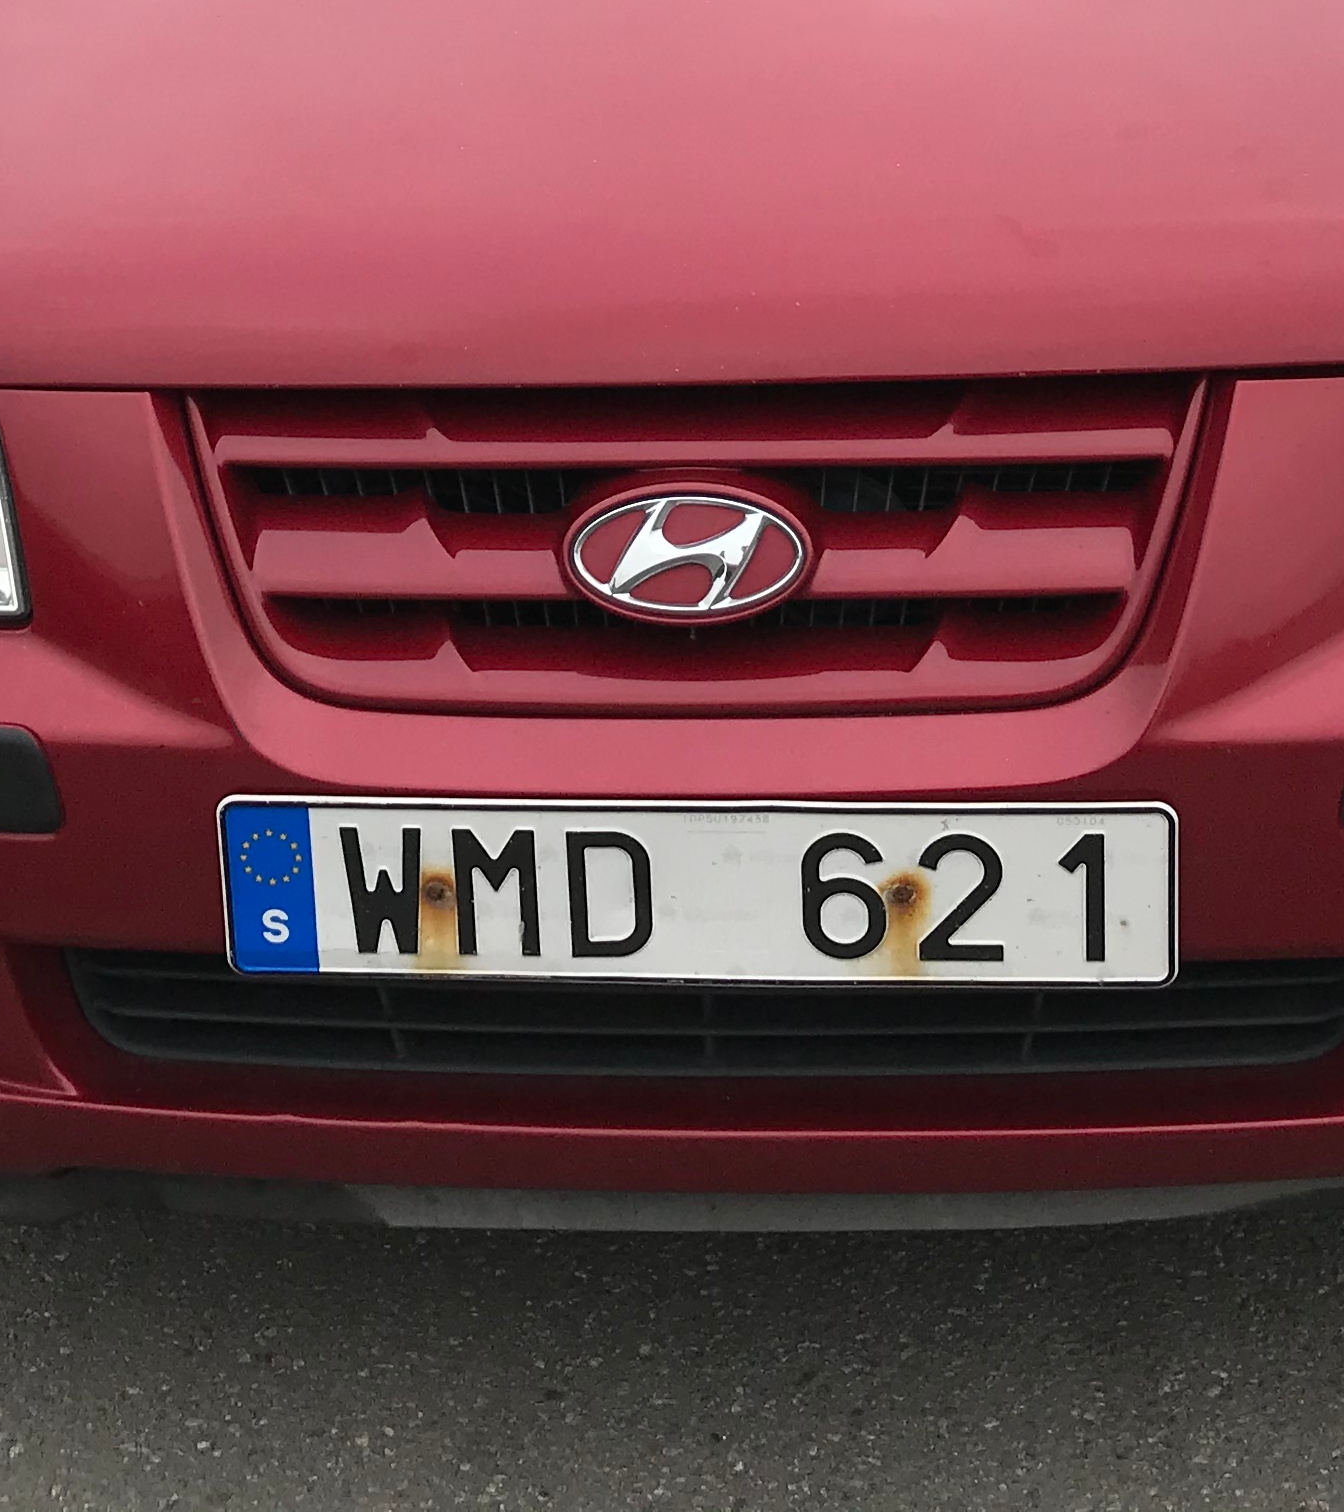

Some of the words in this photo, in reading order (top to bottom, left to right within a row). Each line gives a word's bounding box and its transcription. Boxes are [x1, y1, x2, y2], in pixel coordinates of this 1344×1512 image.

[262, 908, 290, 944] S
[339, 826, 654, 958] WMD
[801, 832, 1106, 962] 621
